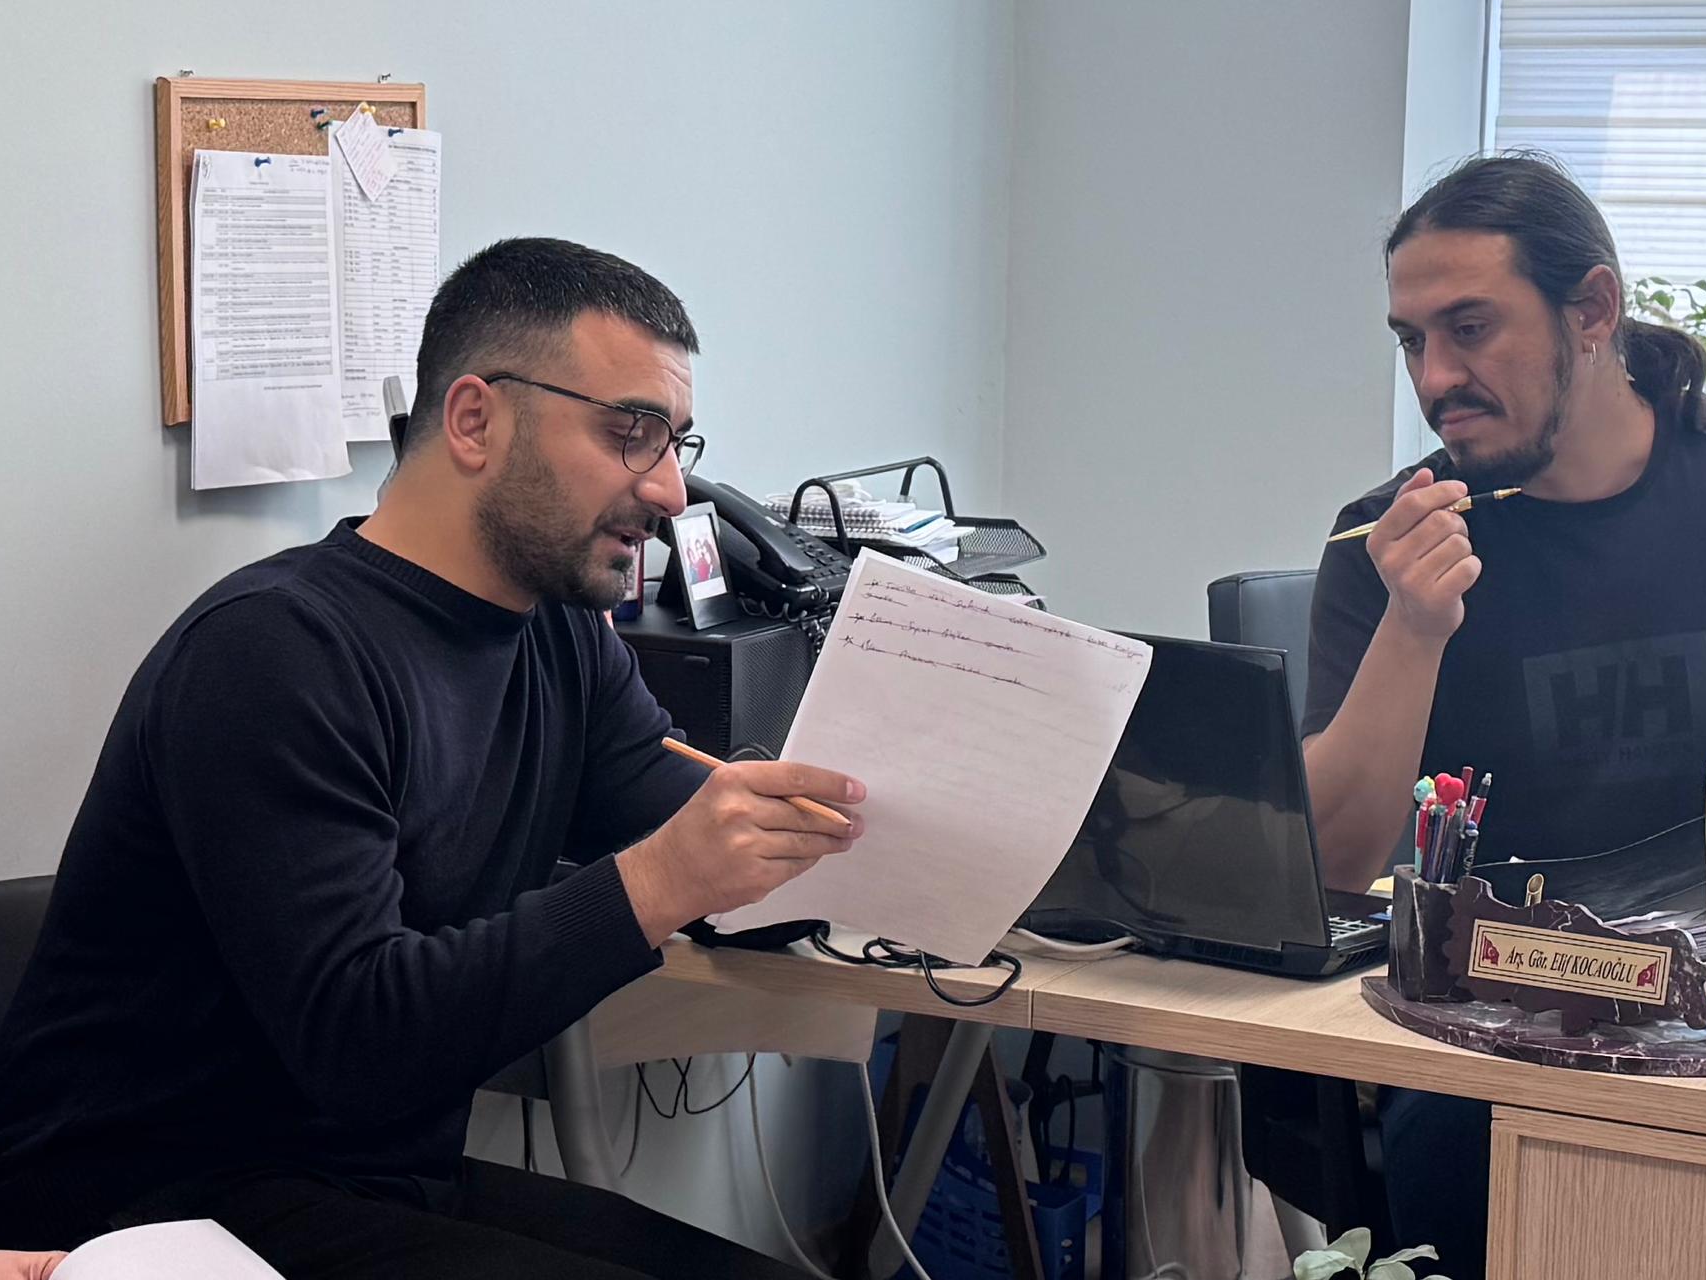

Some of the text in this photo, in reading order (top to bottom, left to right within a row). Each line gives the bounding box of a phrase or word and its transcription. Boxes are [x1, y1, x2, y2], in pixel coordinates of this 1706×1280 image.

[1528, 949, 1547, 969] Gör.
[1549, 952, 1571, 977] Elif
[1571, 955, 1637, 983] KOCAOĞLU
